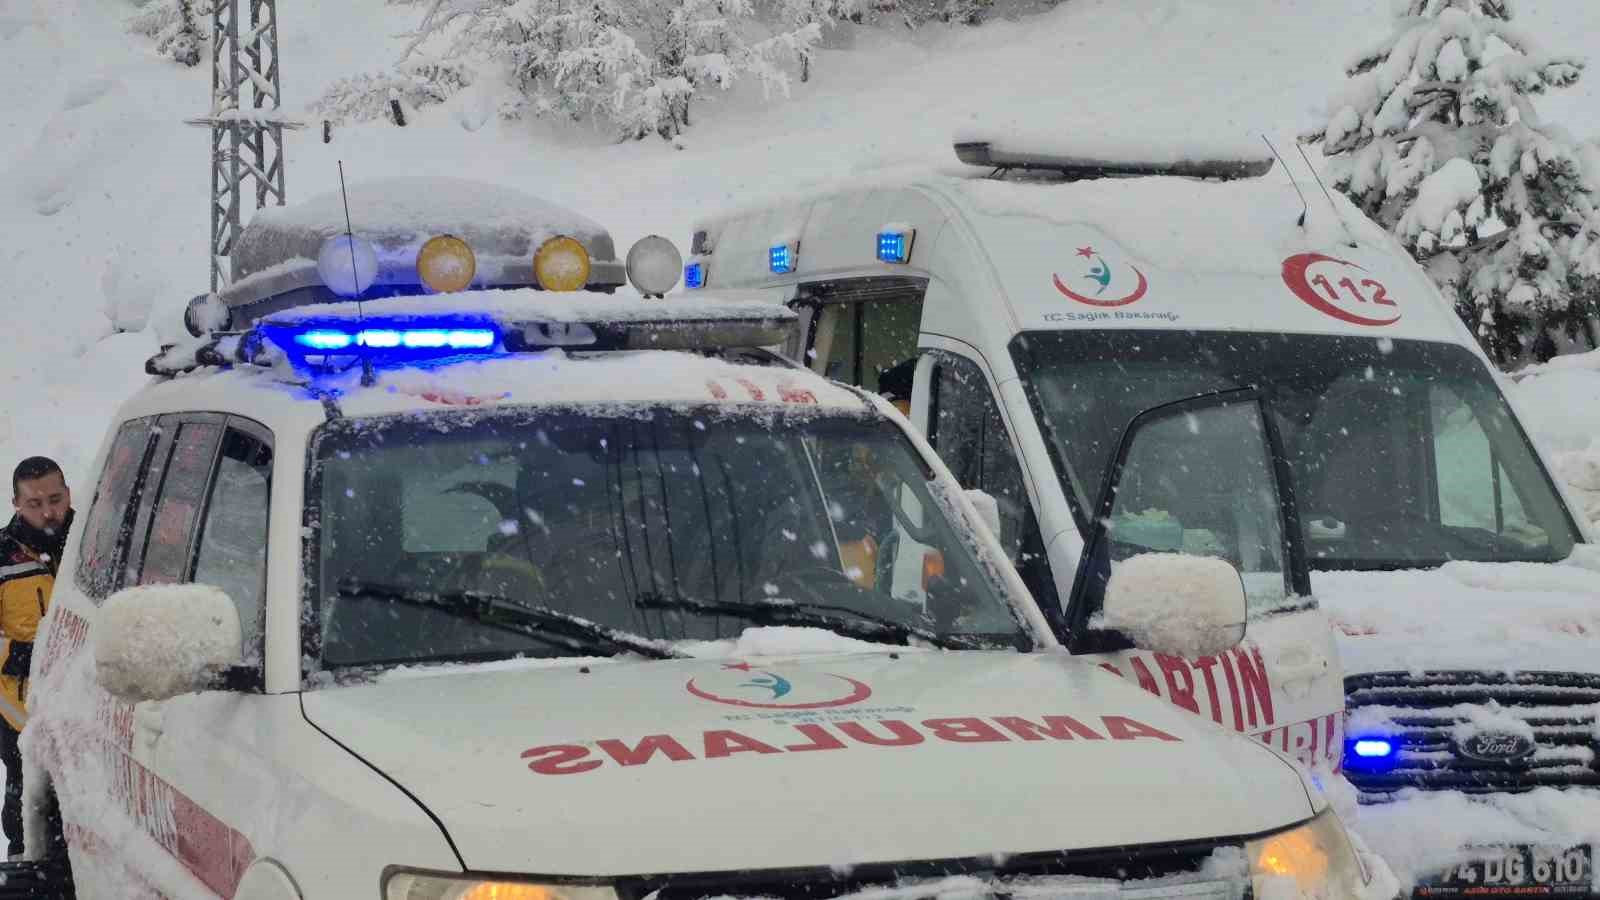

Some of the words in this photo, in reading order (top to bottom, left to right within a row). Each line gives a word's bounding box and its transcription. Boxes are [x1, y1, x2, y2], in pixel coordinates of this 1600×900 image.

[1311, 273, 1396, 306] 112
[1476, 734, 1521, 754] Ford
[1484, 850, 1524, 884] DG
[1533, 848, 1585, 883] 610
